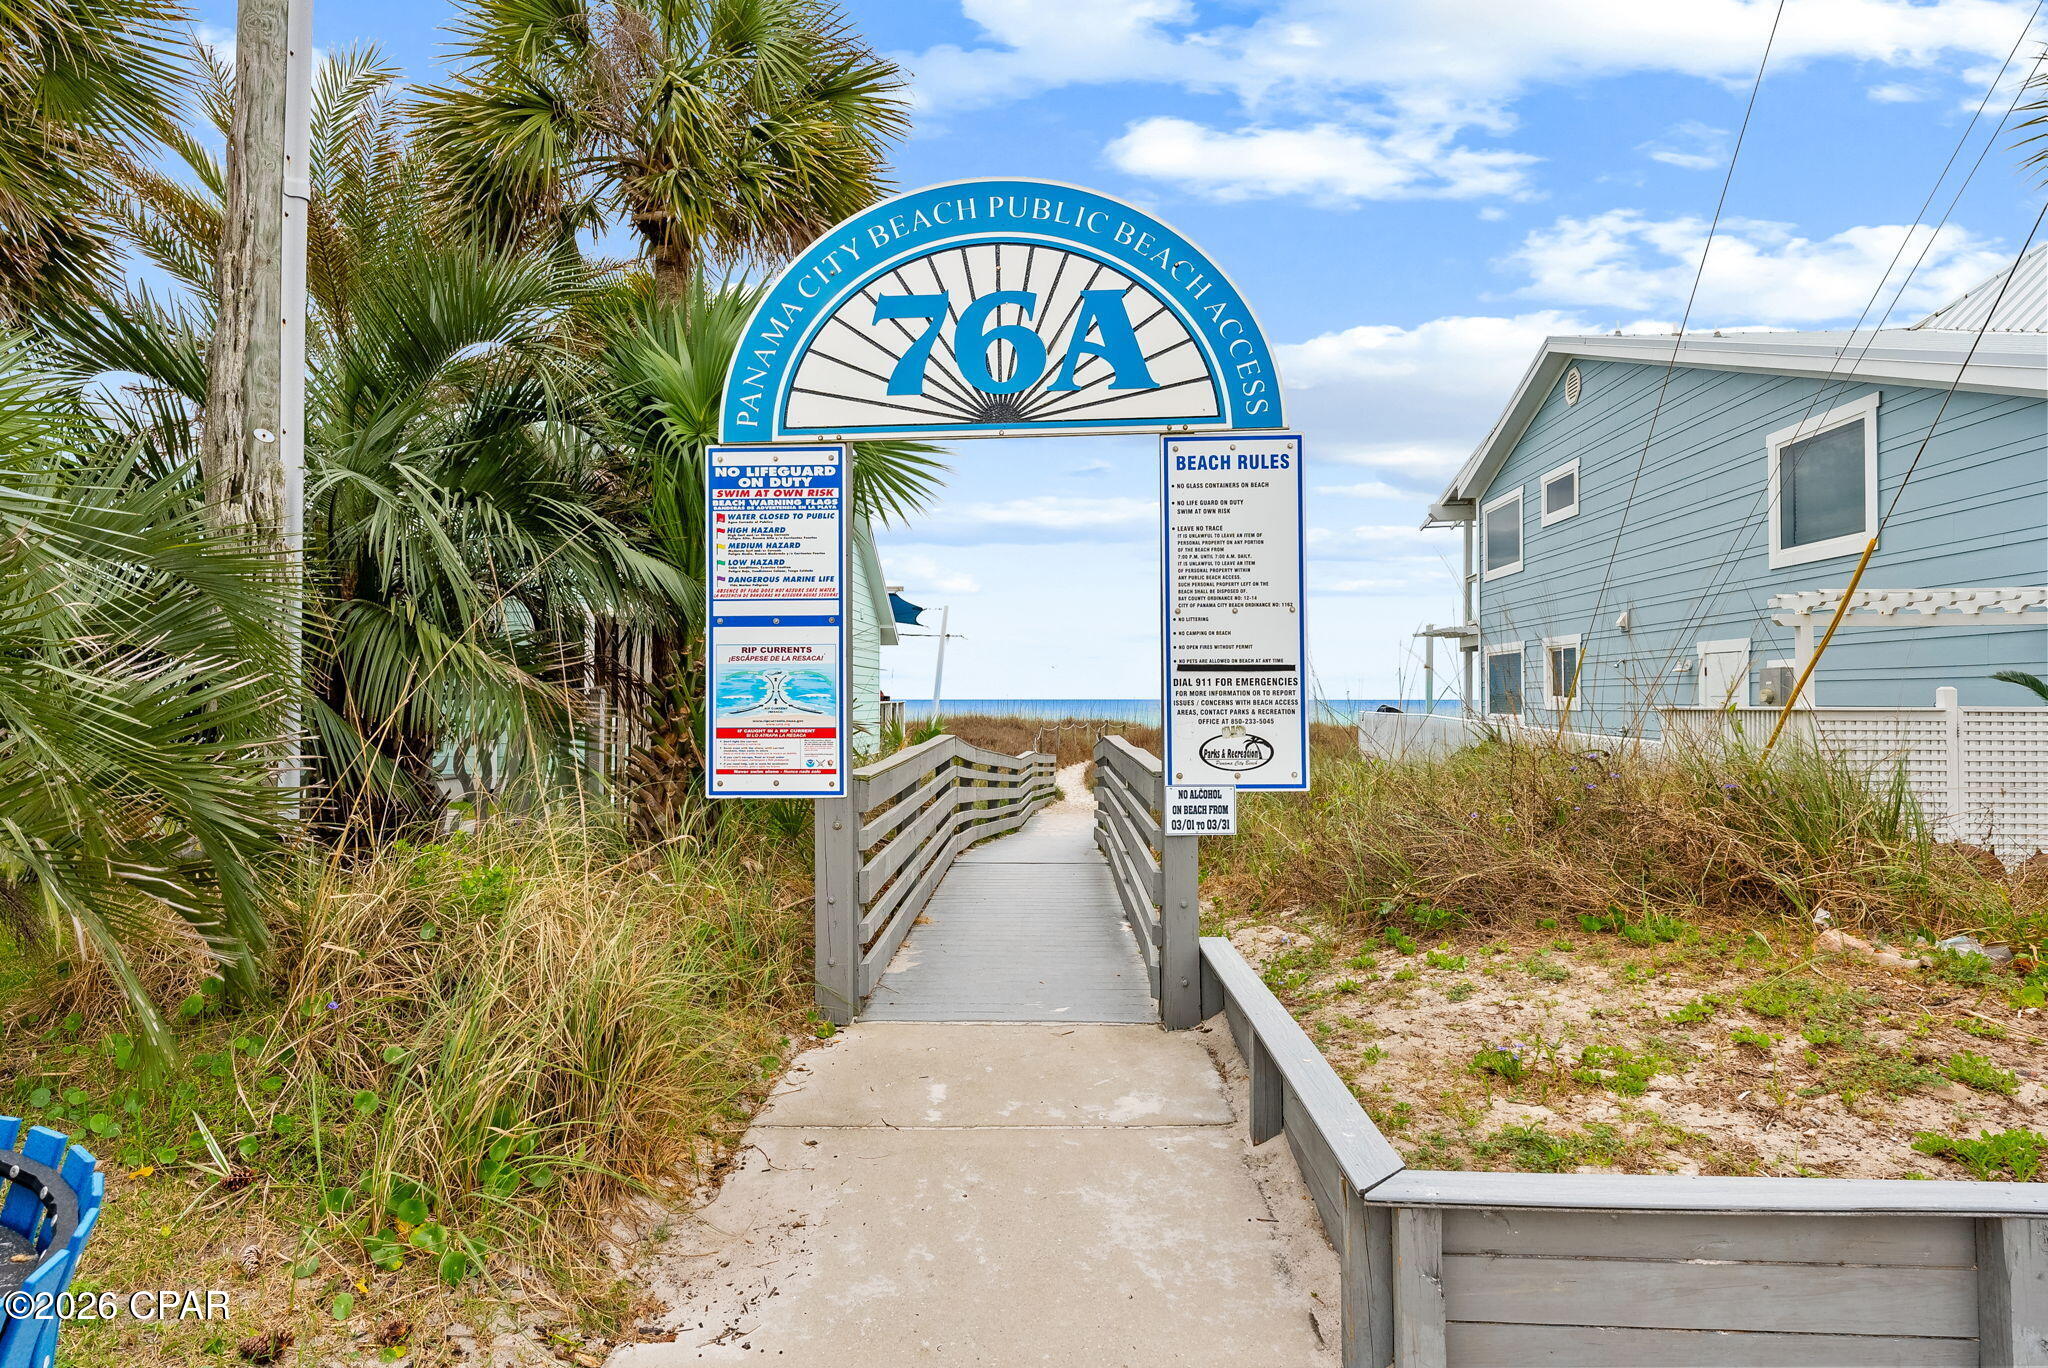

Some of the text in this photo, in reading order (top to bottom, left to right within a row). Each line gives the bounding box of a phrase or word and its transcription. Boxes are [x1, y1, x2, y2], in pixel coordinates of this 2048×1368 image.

[736, 196, 1268, 427] PANAMA CITY BEACH PUBLIC BEACH ACCESS
[872, 289, 1160, 395] 76A
[1176, 454, 1290, 470] BEACH RULES
[715, 466, 836, 477] NO LIFEGUARD
[738, 477, 812, 487] ON DUTY
[1236, 678, 1298, 686] EMERGENCIES
[1204, 749, 1258, 759] Parks & Recreation
[1178, 790, 1222, 799] NO ALCOHOL
[1172, 805, 1228, 814] ON BEACH FROM
[1172, 820, 1194, 830] 03/01
[1207, 819, 1229, 830] 03/31
